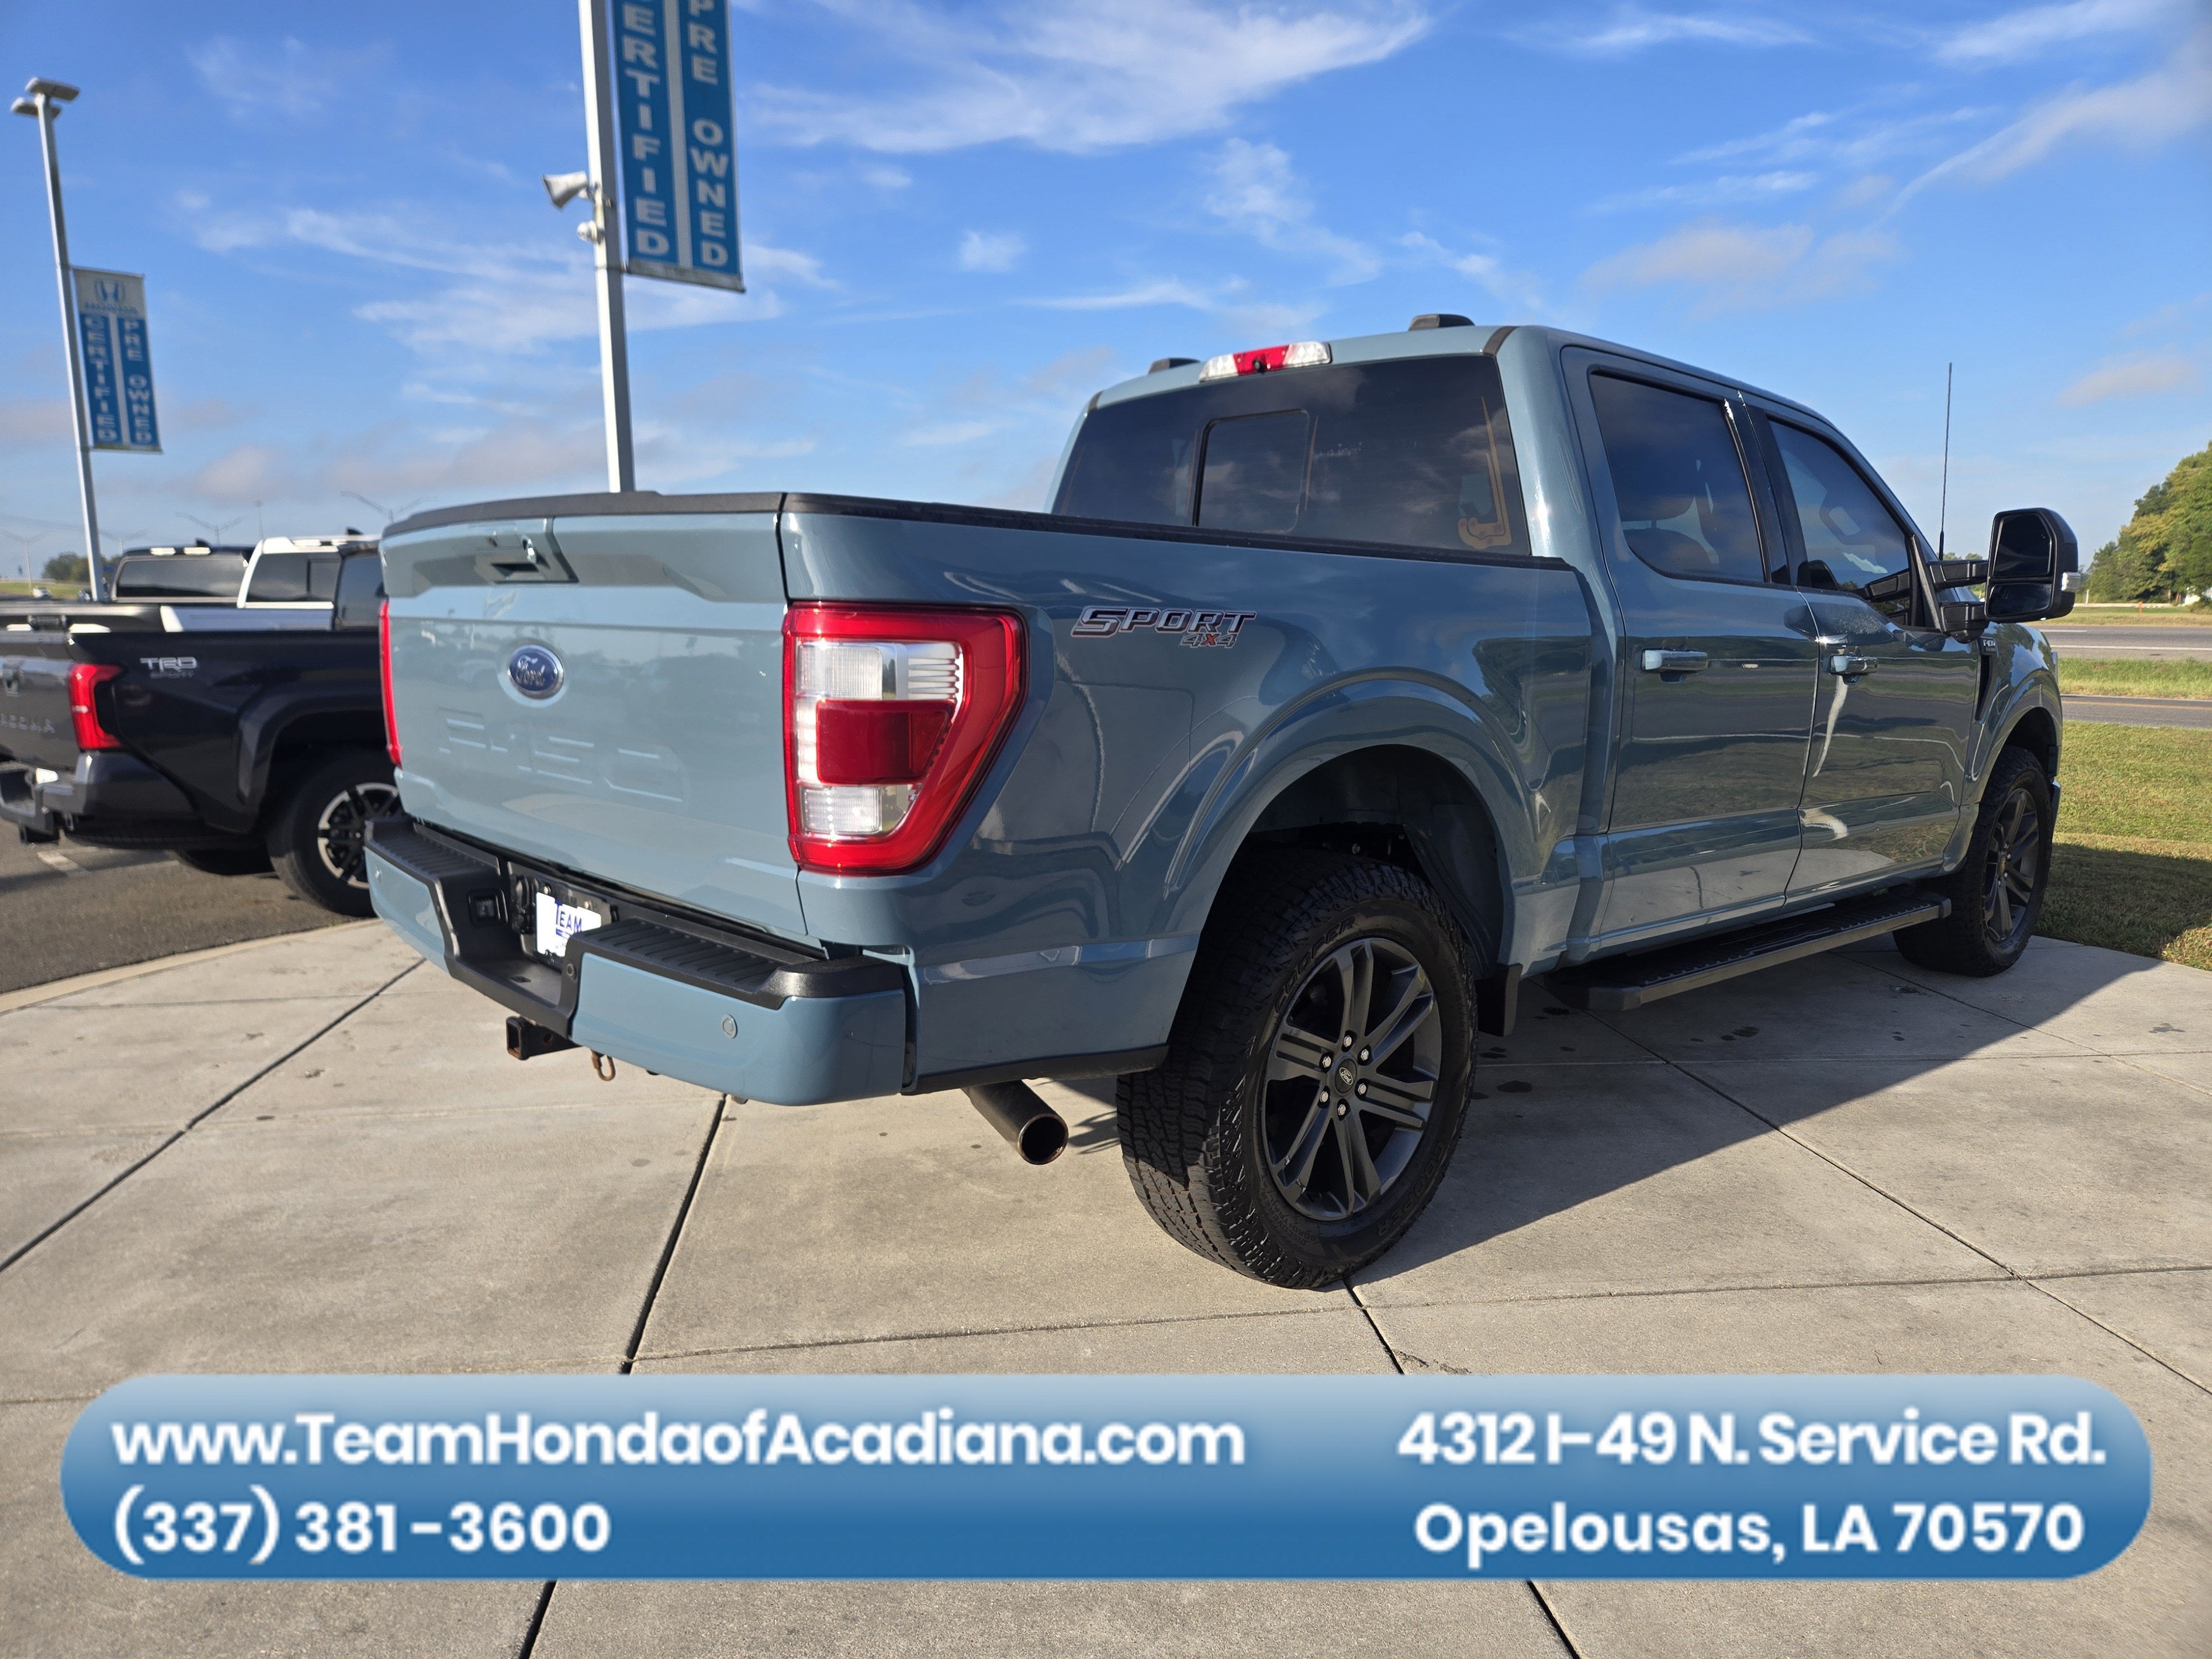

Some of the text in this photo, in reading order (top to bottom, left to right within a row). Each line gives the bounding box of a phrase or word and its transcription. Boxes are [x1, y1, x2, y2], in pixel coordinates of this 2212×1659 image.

[622, 0, 670, 257] ERTIFIED
[688, 118, 729, 268] OWNED
[123, 318, 153, 444] PRE OWNED
[1070, 606, 1257, 638] SPORT
[139, 656, 197, 673] TRD
[555, 898, 582, 933] TEAM
